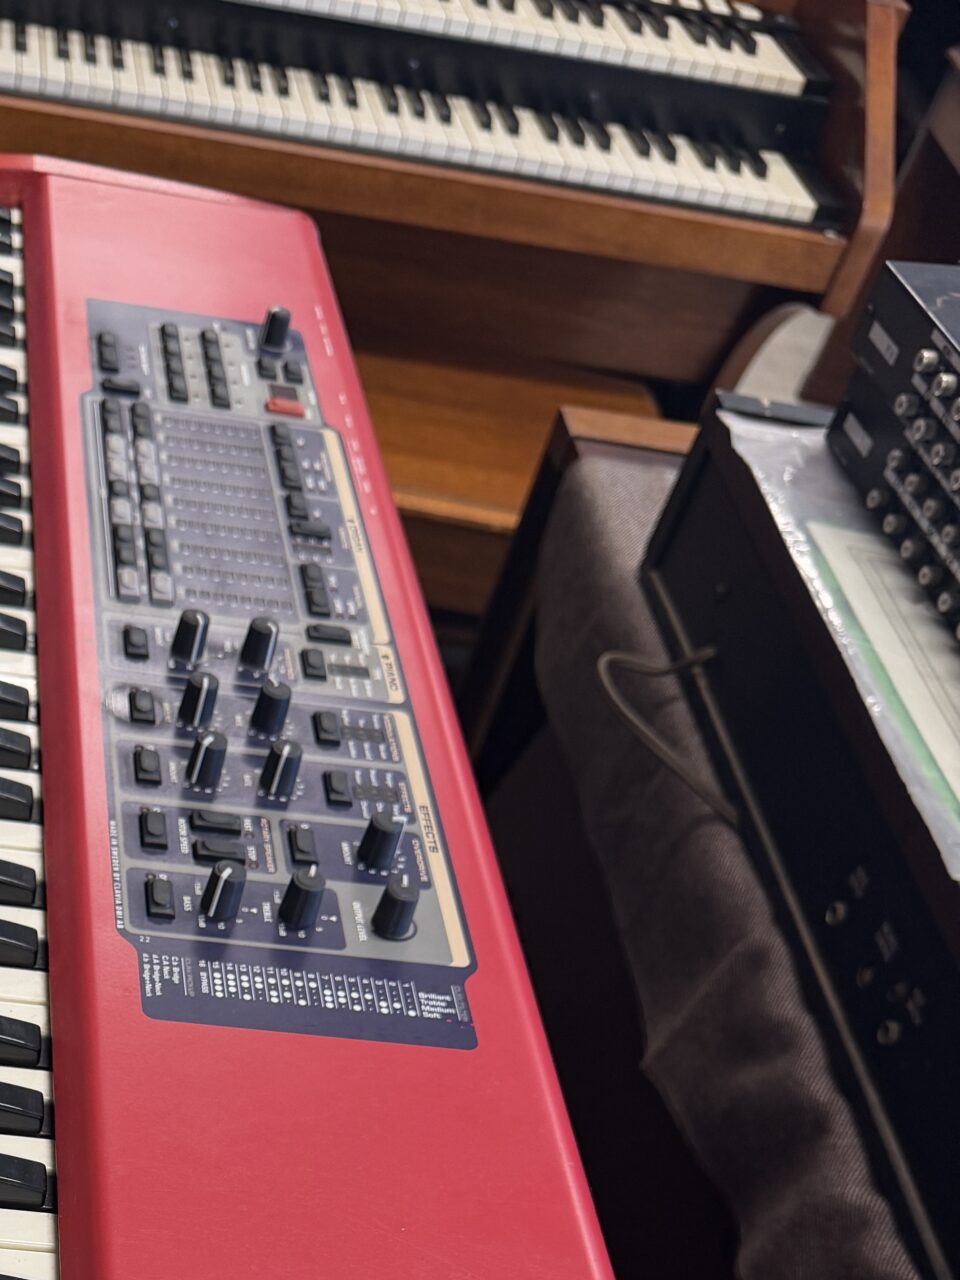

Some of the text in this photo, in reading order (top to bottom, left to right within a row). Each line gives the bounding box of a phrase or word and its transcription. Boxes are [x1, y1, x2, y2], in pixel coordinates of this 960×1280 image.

[419, 805, 438, 853] EFFECTS
[111, 846, 120, 872] SWEDEN
[247, 846, 256, 861] STOP
[264, 843, 275, 873] SPEAKER
[411, 839, 428, 882] OVERDRIVE
[114, 882, 123, 904] CLAVIA
[183, 896, 192, 911] BASS
[352, 902, 363, 923] OUTPUT
[171, 967, 180, 984] Bridge
[200, 972, 209, 994] BYPASS
[419, 999, 447, 1007] Treble
[421, 1005, 456, 1014] Medium
[423, 1011, 442, 1019] Soft
